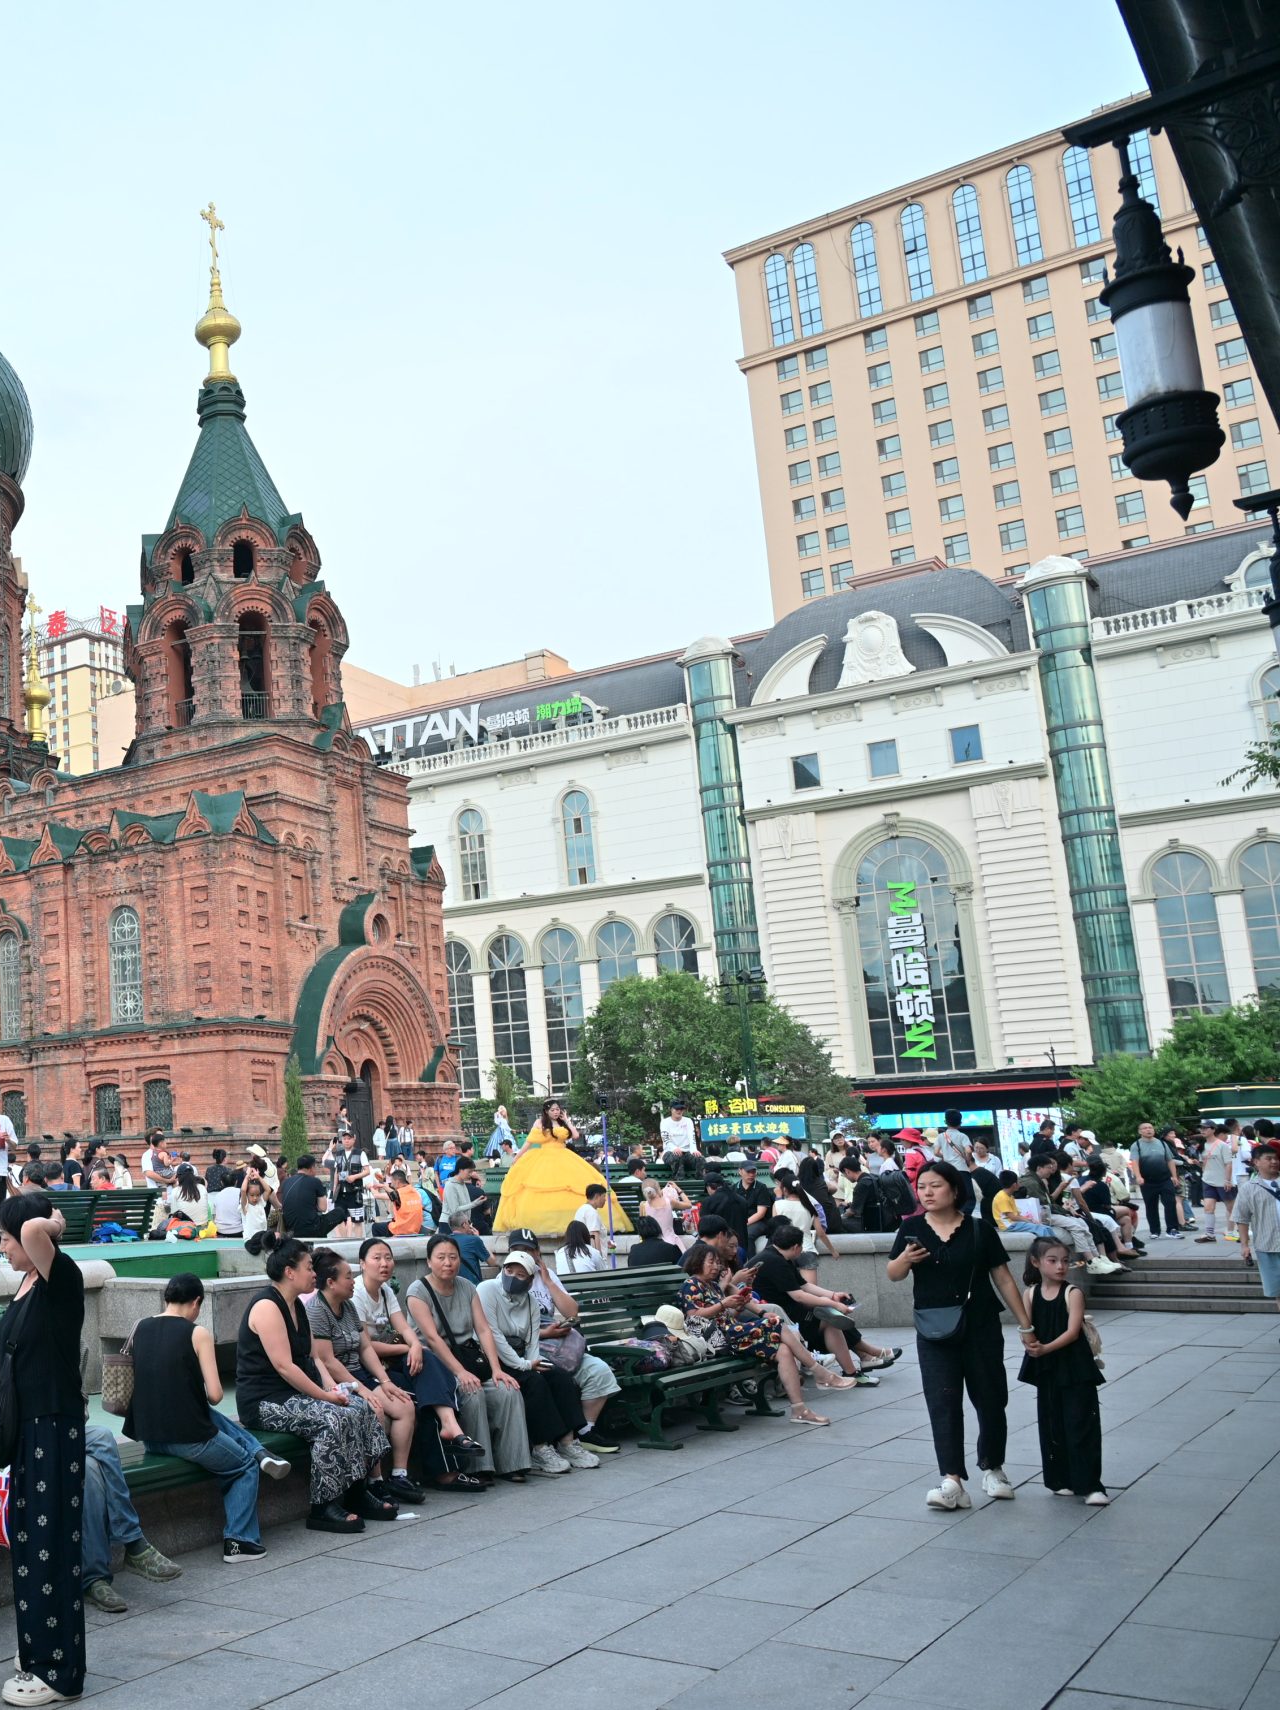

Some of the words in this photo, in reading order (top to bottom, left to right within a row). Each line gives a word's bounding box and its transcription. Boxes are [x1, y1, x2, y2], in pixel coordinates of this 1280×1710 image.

[487, 707, 530, 729] 曼哈顿
[765, 1104, 805, 1113] CONSULTING
